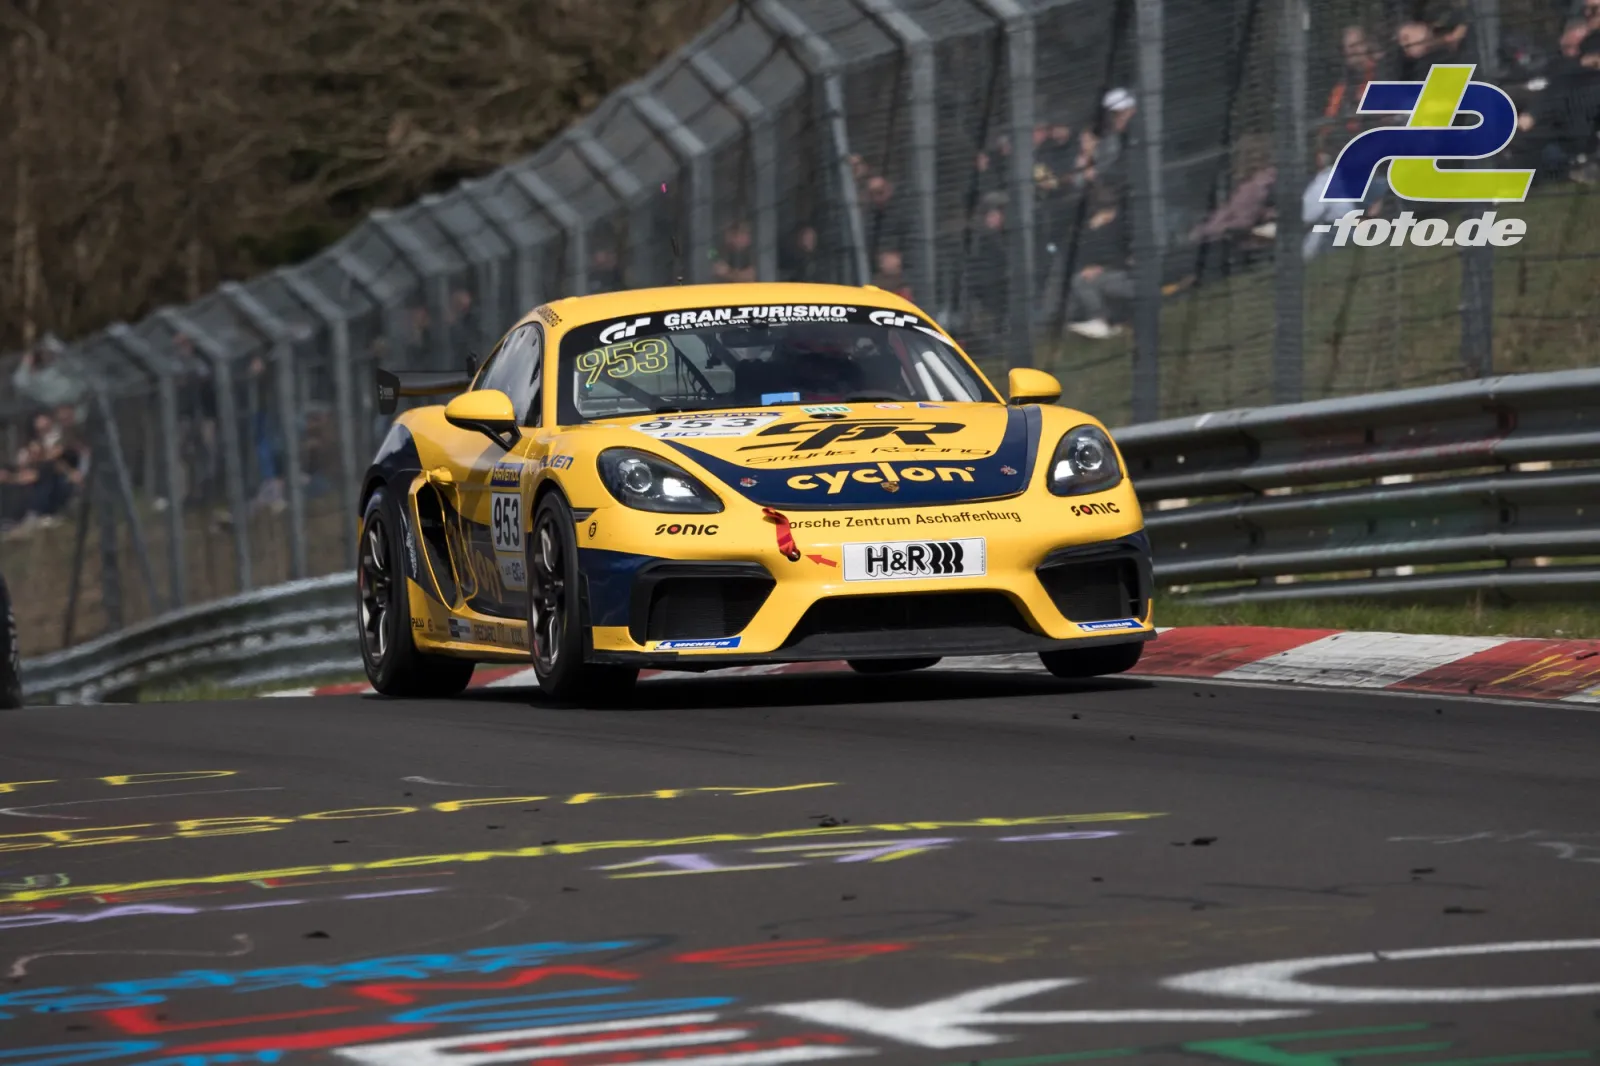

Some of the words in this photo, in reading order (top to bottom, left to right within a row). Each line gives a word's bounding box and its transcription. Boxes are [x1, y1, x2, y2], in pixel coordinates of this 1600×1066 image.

[664, 308, 732, 327] GRAN
[668, 324, 693, 332] THE
[695, 321, 727, 329] REAL
[779, 316, 848, 324] SIMULATOR
[577, 338, 669, 386] 953
[638, 416, 757, 432] 953
[871, 445, 992, 456] Racing
[493, 496, 520, 547] 953
[785, 517, 841, 530] orsche
[845, 514, 911, 528] Zentrum
[915, 510, 1022, 527] Aschaffenburg
[864, 543, 930, 577] H&R
[674, 640, 731, 648] MICHELIN
